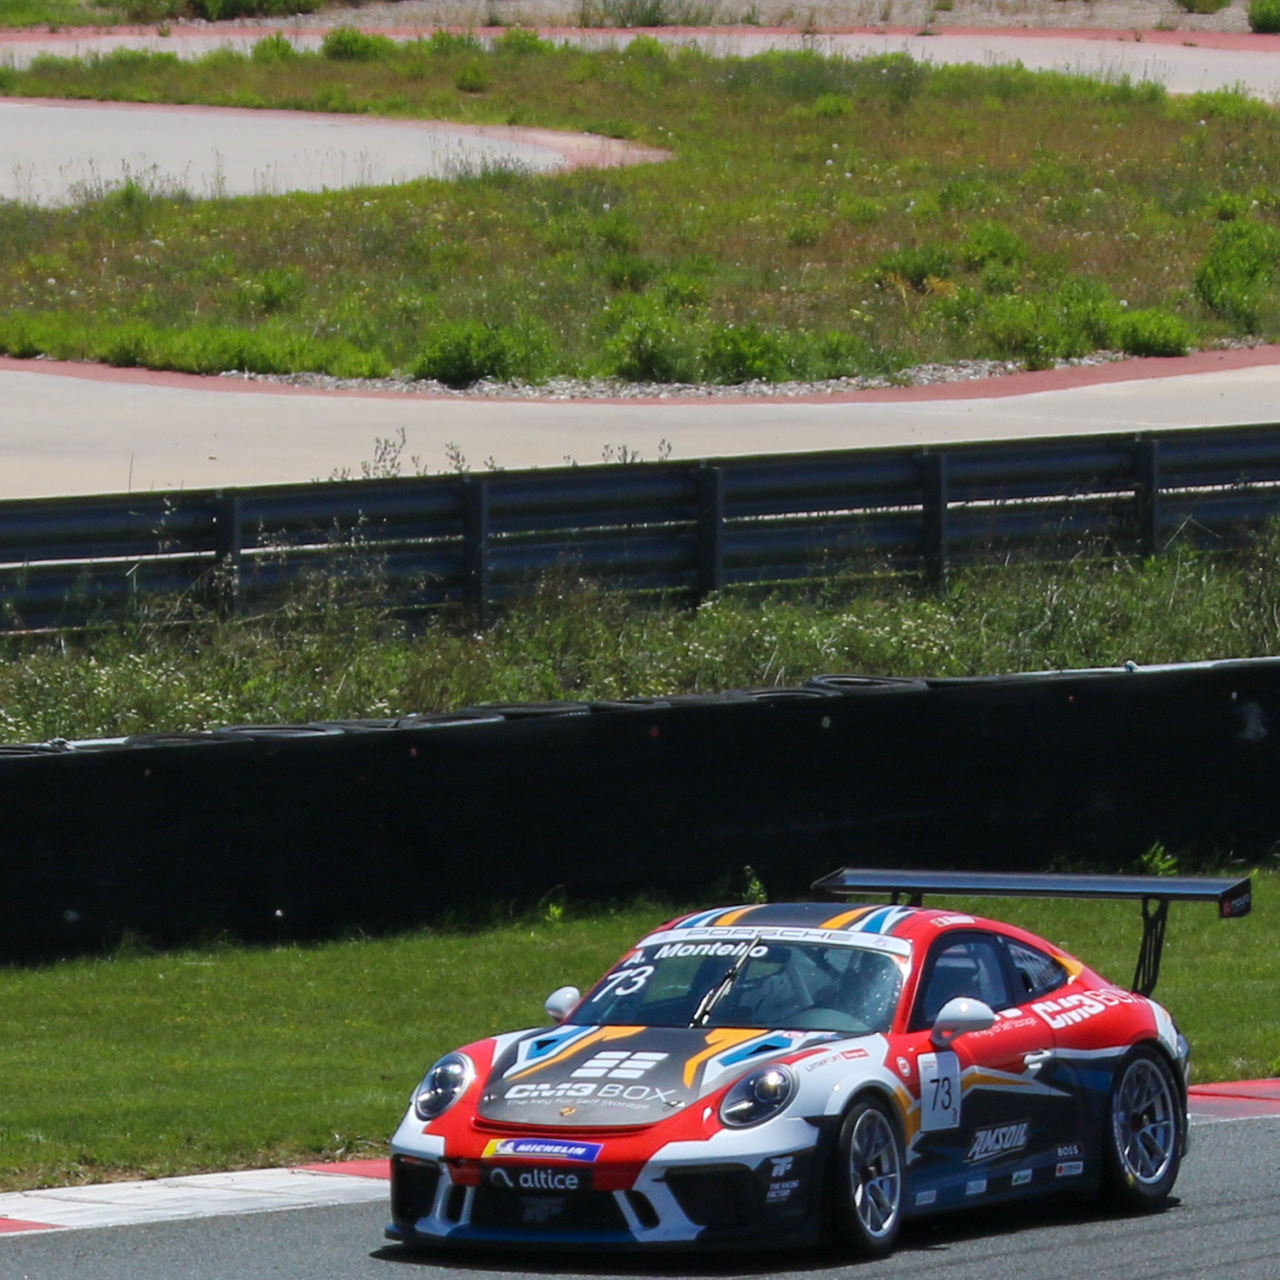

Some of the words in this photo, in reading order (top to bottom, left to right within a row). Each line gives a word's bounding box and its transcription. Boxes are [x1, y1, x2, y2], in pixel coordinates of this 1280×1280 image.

[686, 928, 852, 941] PORSCHE
[591, 965, 655, 1003] 73
[930, 1076, 953, 1111] 73
[516, 1143, 587, 1155] MICHELIN
[967, 1122, 1029, 1161] AMSOIL
[1057, 1145, 1080, 1157] BOSS
[519, 1170, 579, 1190] altice
